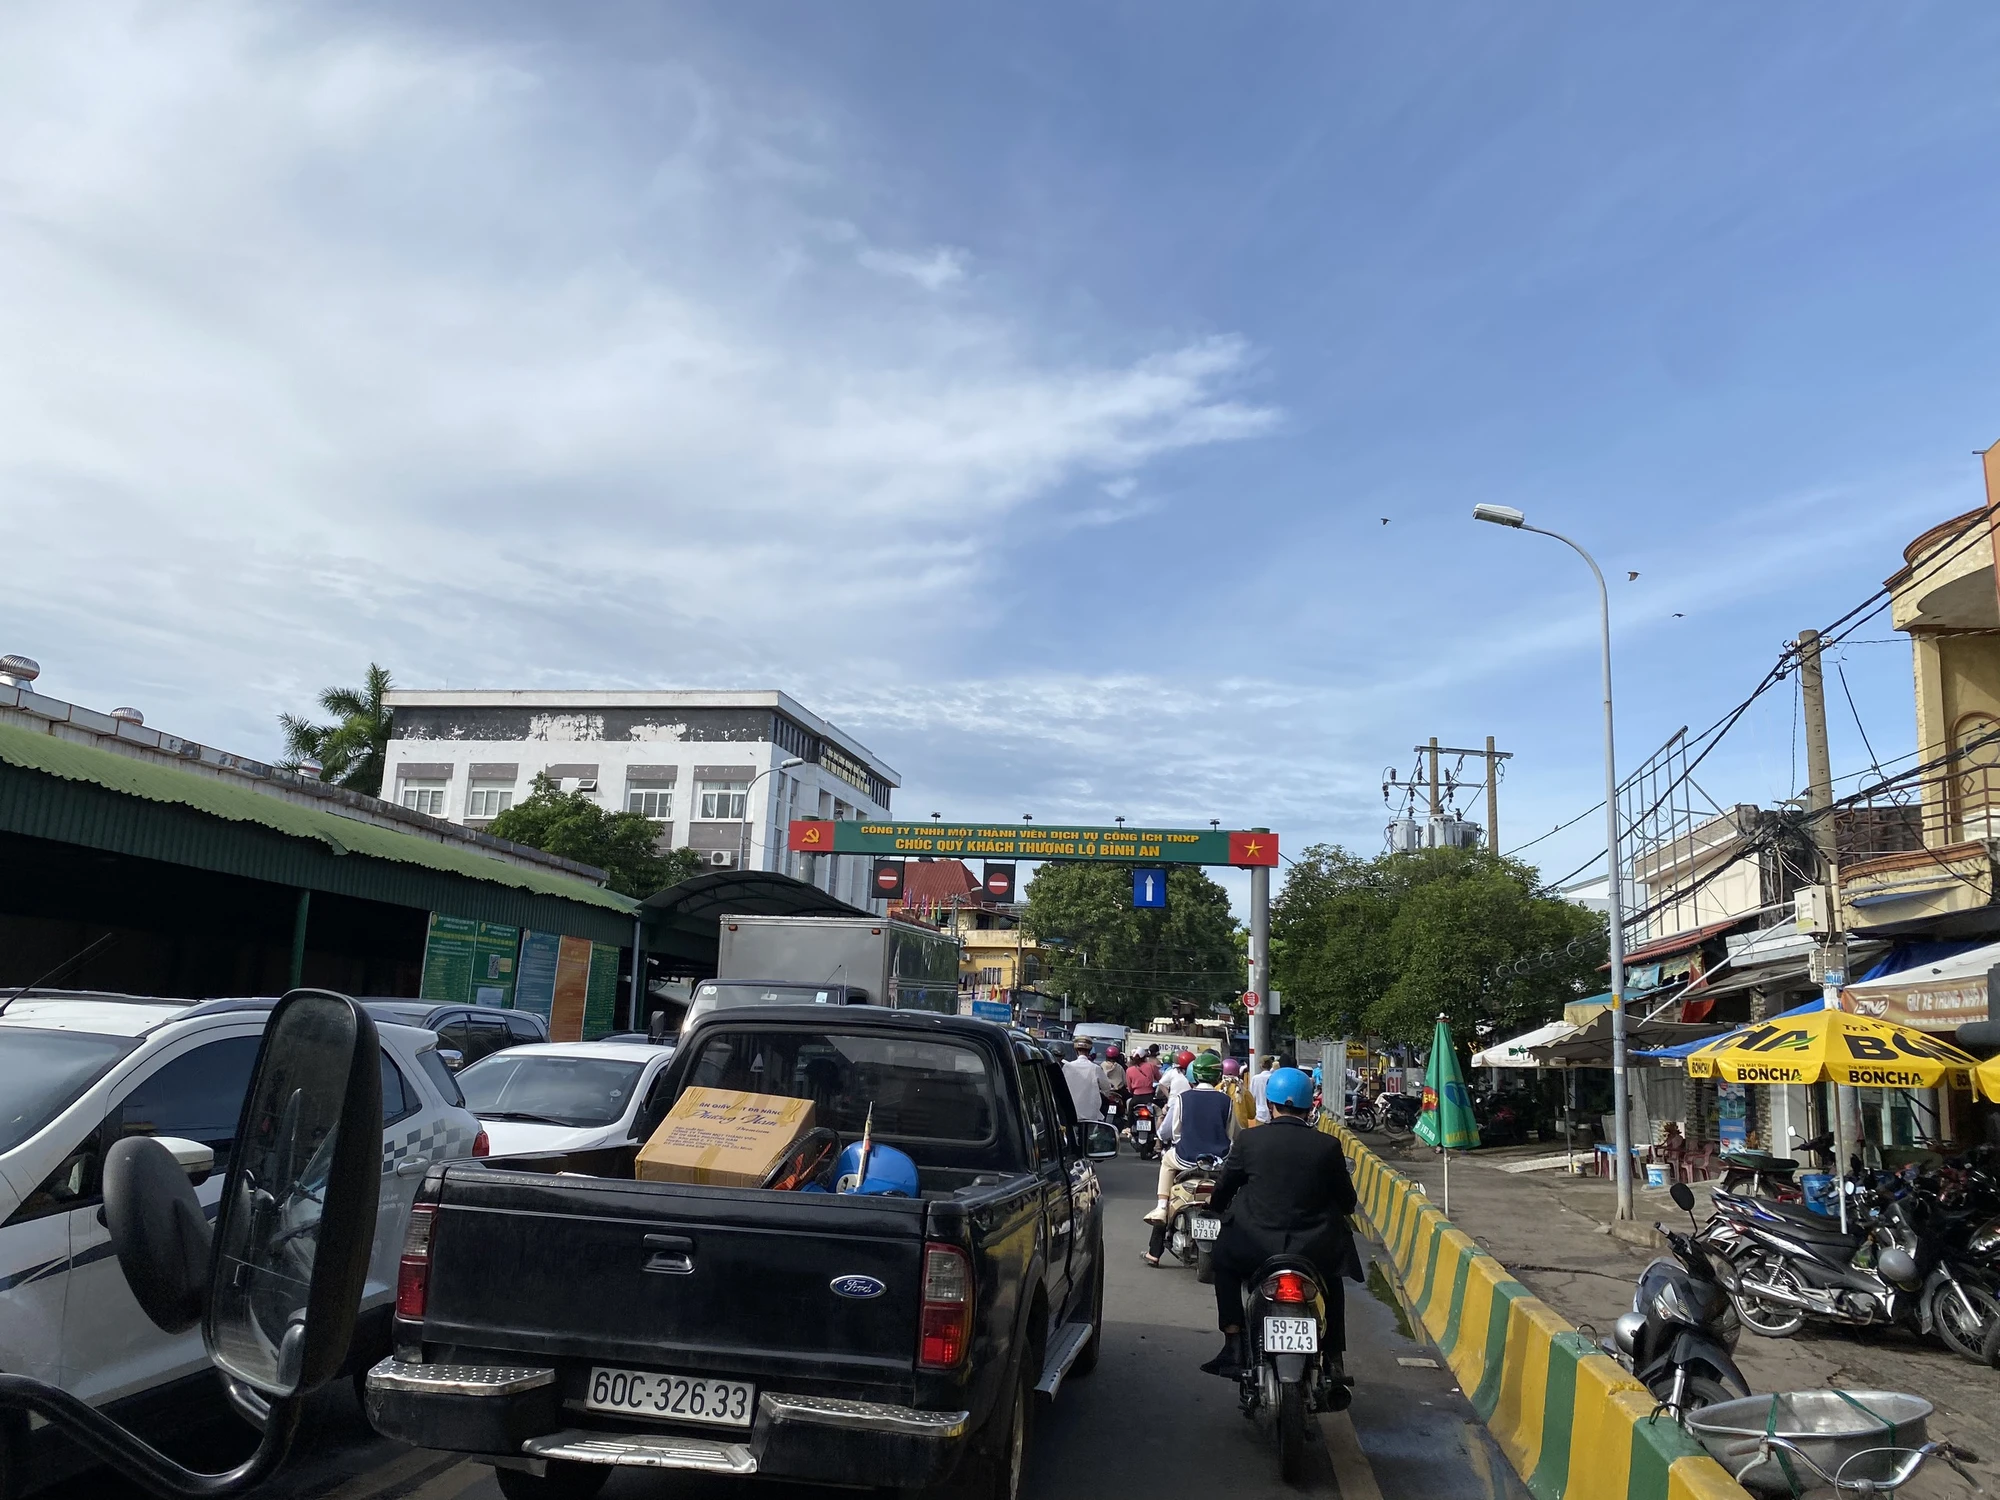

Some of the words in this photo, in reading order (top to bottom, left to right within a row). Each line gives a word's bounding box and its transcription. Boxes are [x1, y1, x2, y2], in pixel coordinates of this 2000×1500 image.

[861, 825, 893, 835] CÔNG
[897, 827, 910, 835] TY
[914, 828, 945, 836] TNHH
[948, 828, 974, 839] MỘT
[977, 827, 1017, 839] THÀNH
[1020, 828, 1047, 840] VIÊN
[1051, 831, 1079, 841] DỊCH
[1083, 832, 1099, 842] VỤ
[1103, 831, 1138, 842] CÔNG
[1142, 832, 1162, 842] ÍCH
[1166, 834, 1199, 843] TNXP
[895, 837, 932, 851] CHÚC
[936, 837, 963, 852] QUÝ
[967, 839, 1015, 853] KHÁCH
[1018, 841, 1074, 857] THƯỢNG
[1078, 841, 1096, 858] LỘ
[1100, 841, 1135, 857] BÌNH
[1139, 845, 1160, 857] AN
[1737, 1068, 1803, 1081] BONCHA
[1849, 1070, 1924, 1086] BONCHA
[740, 1114, 777, 1126] Nam
[844, 1279, 873, 1293] Ford
[1272, 1320, 1309, 1335] 59-ZB
[1270, 1335, 1313, 1350] 112.43
[593, 1371, 748, 1420] 60C-326.33
